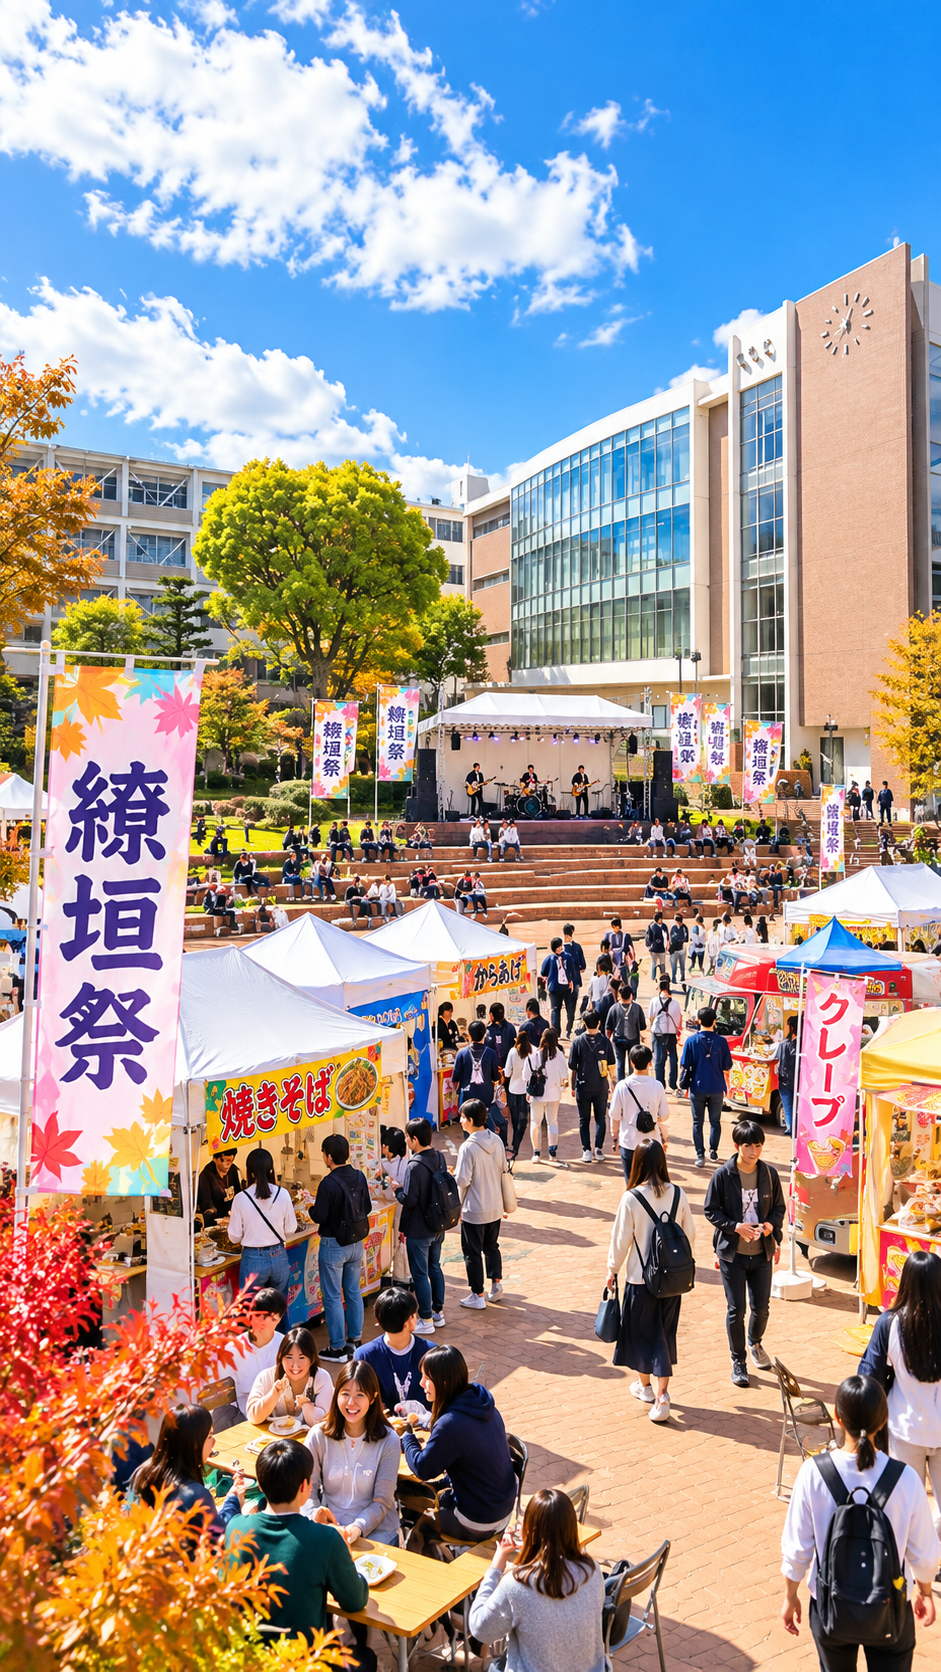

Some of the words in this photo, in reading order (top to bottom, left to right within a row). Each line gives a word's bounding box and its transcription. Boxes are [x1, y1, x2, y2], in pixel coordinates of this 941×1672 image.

[54, 760, 171, 1091] 繚垣祭
[473, 954, 526, 992] からあげ
[220, 1062, 336, 1144] 焼きそば
[811, 992, 850, 1128] クレープ
